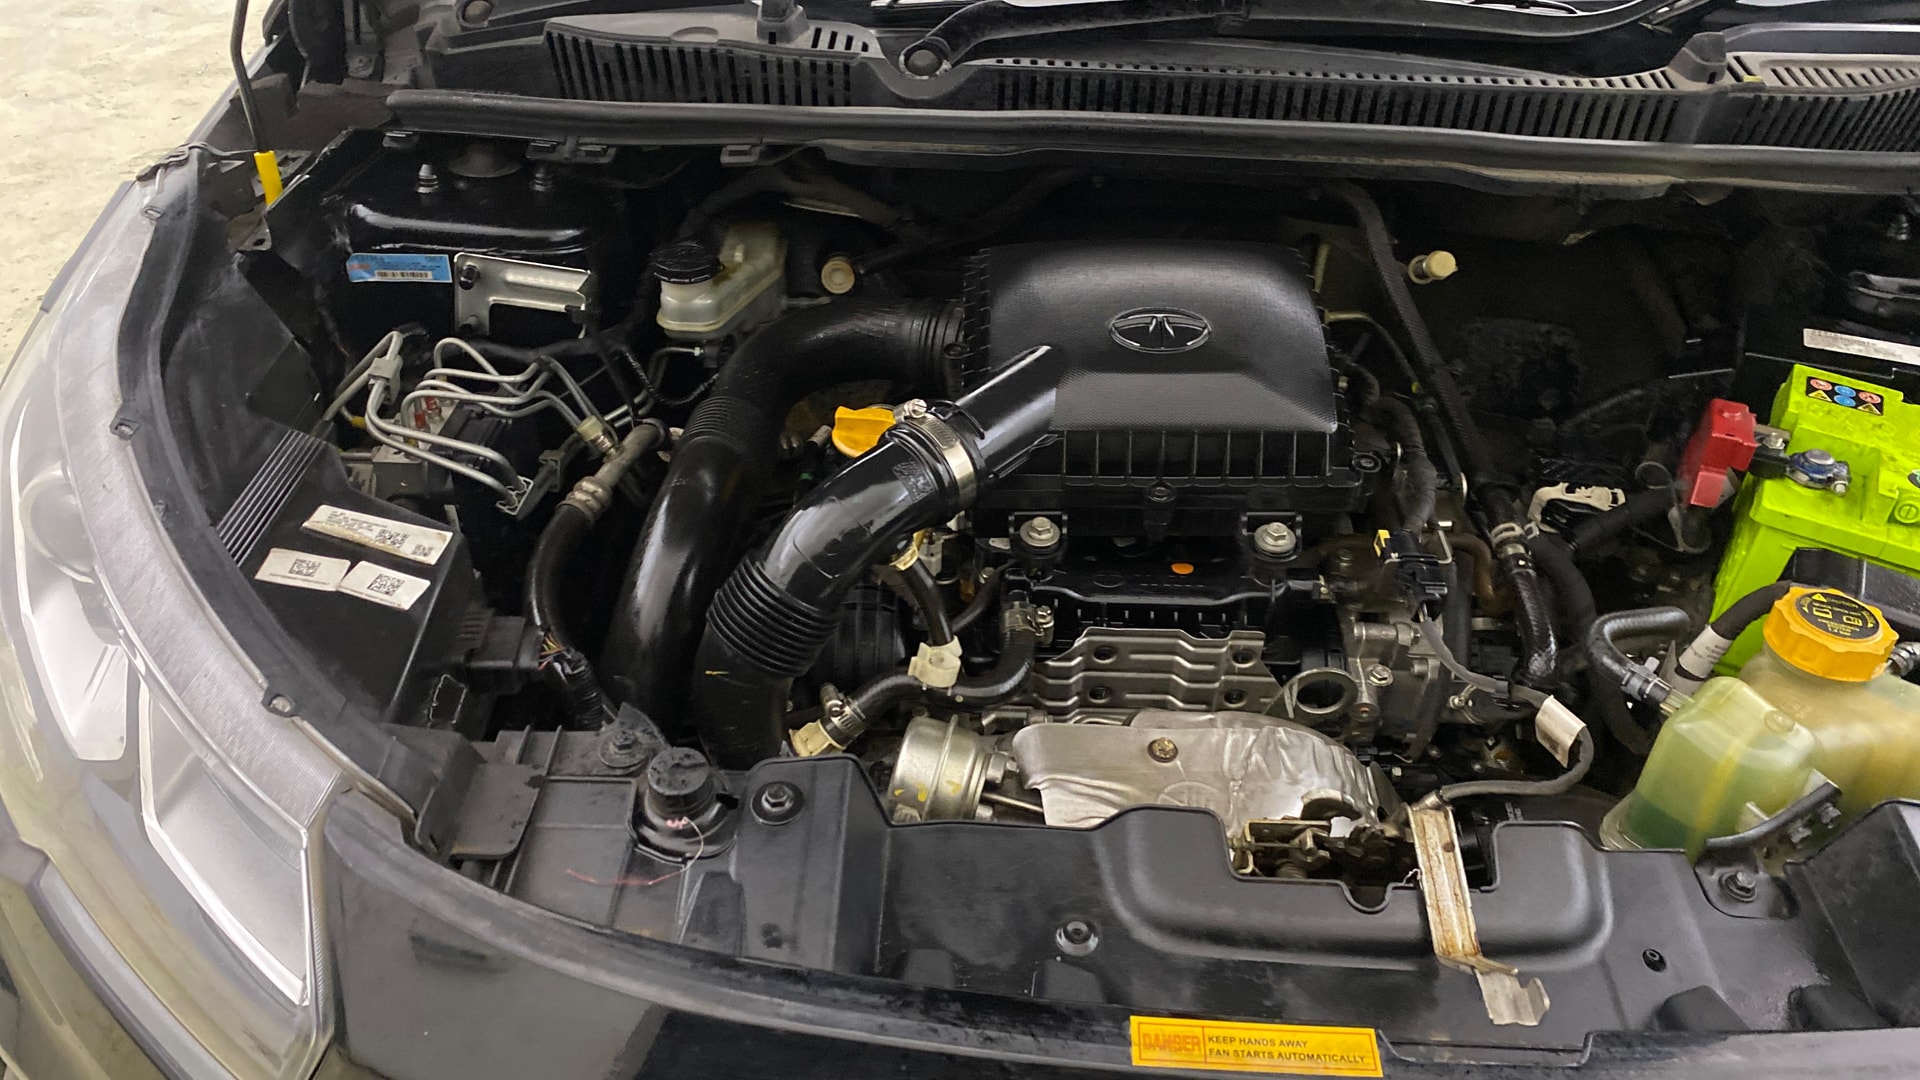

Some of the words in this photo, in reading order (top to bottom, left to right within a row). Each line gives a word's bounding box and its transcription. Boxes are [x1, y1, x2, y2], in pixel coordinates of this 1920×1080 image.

[1207, 1035, 1236, 1045] KEEP
[1240, 1037, 1276, 1047] HANDS
[1279, 1039, 1308, 1049] AWAY
[1209, 1048, 1230, 1057] FAN
[1233, 1049, 1274, 1059] STARTS
[1277, 1051, 1365, 1064] AUTOMATICALLY
